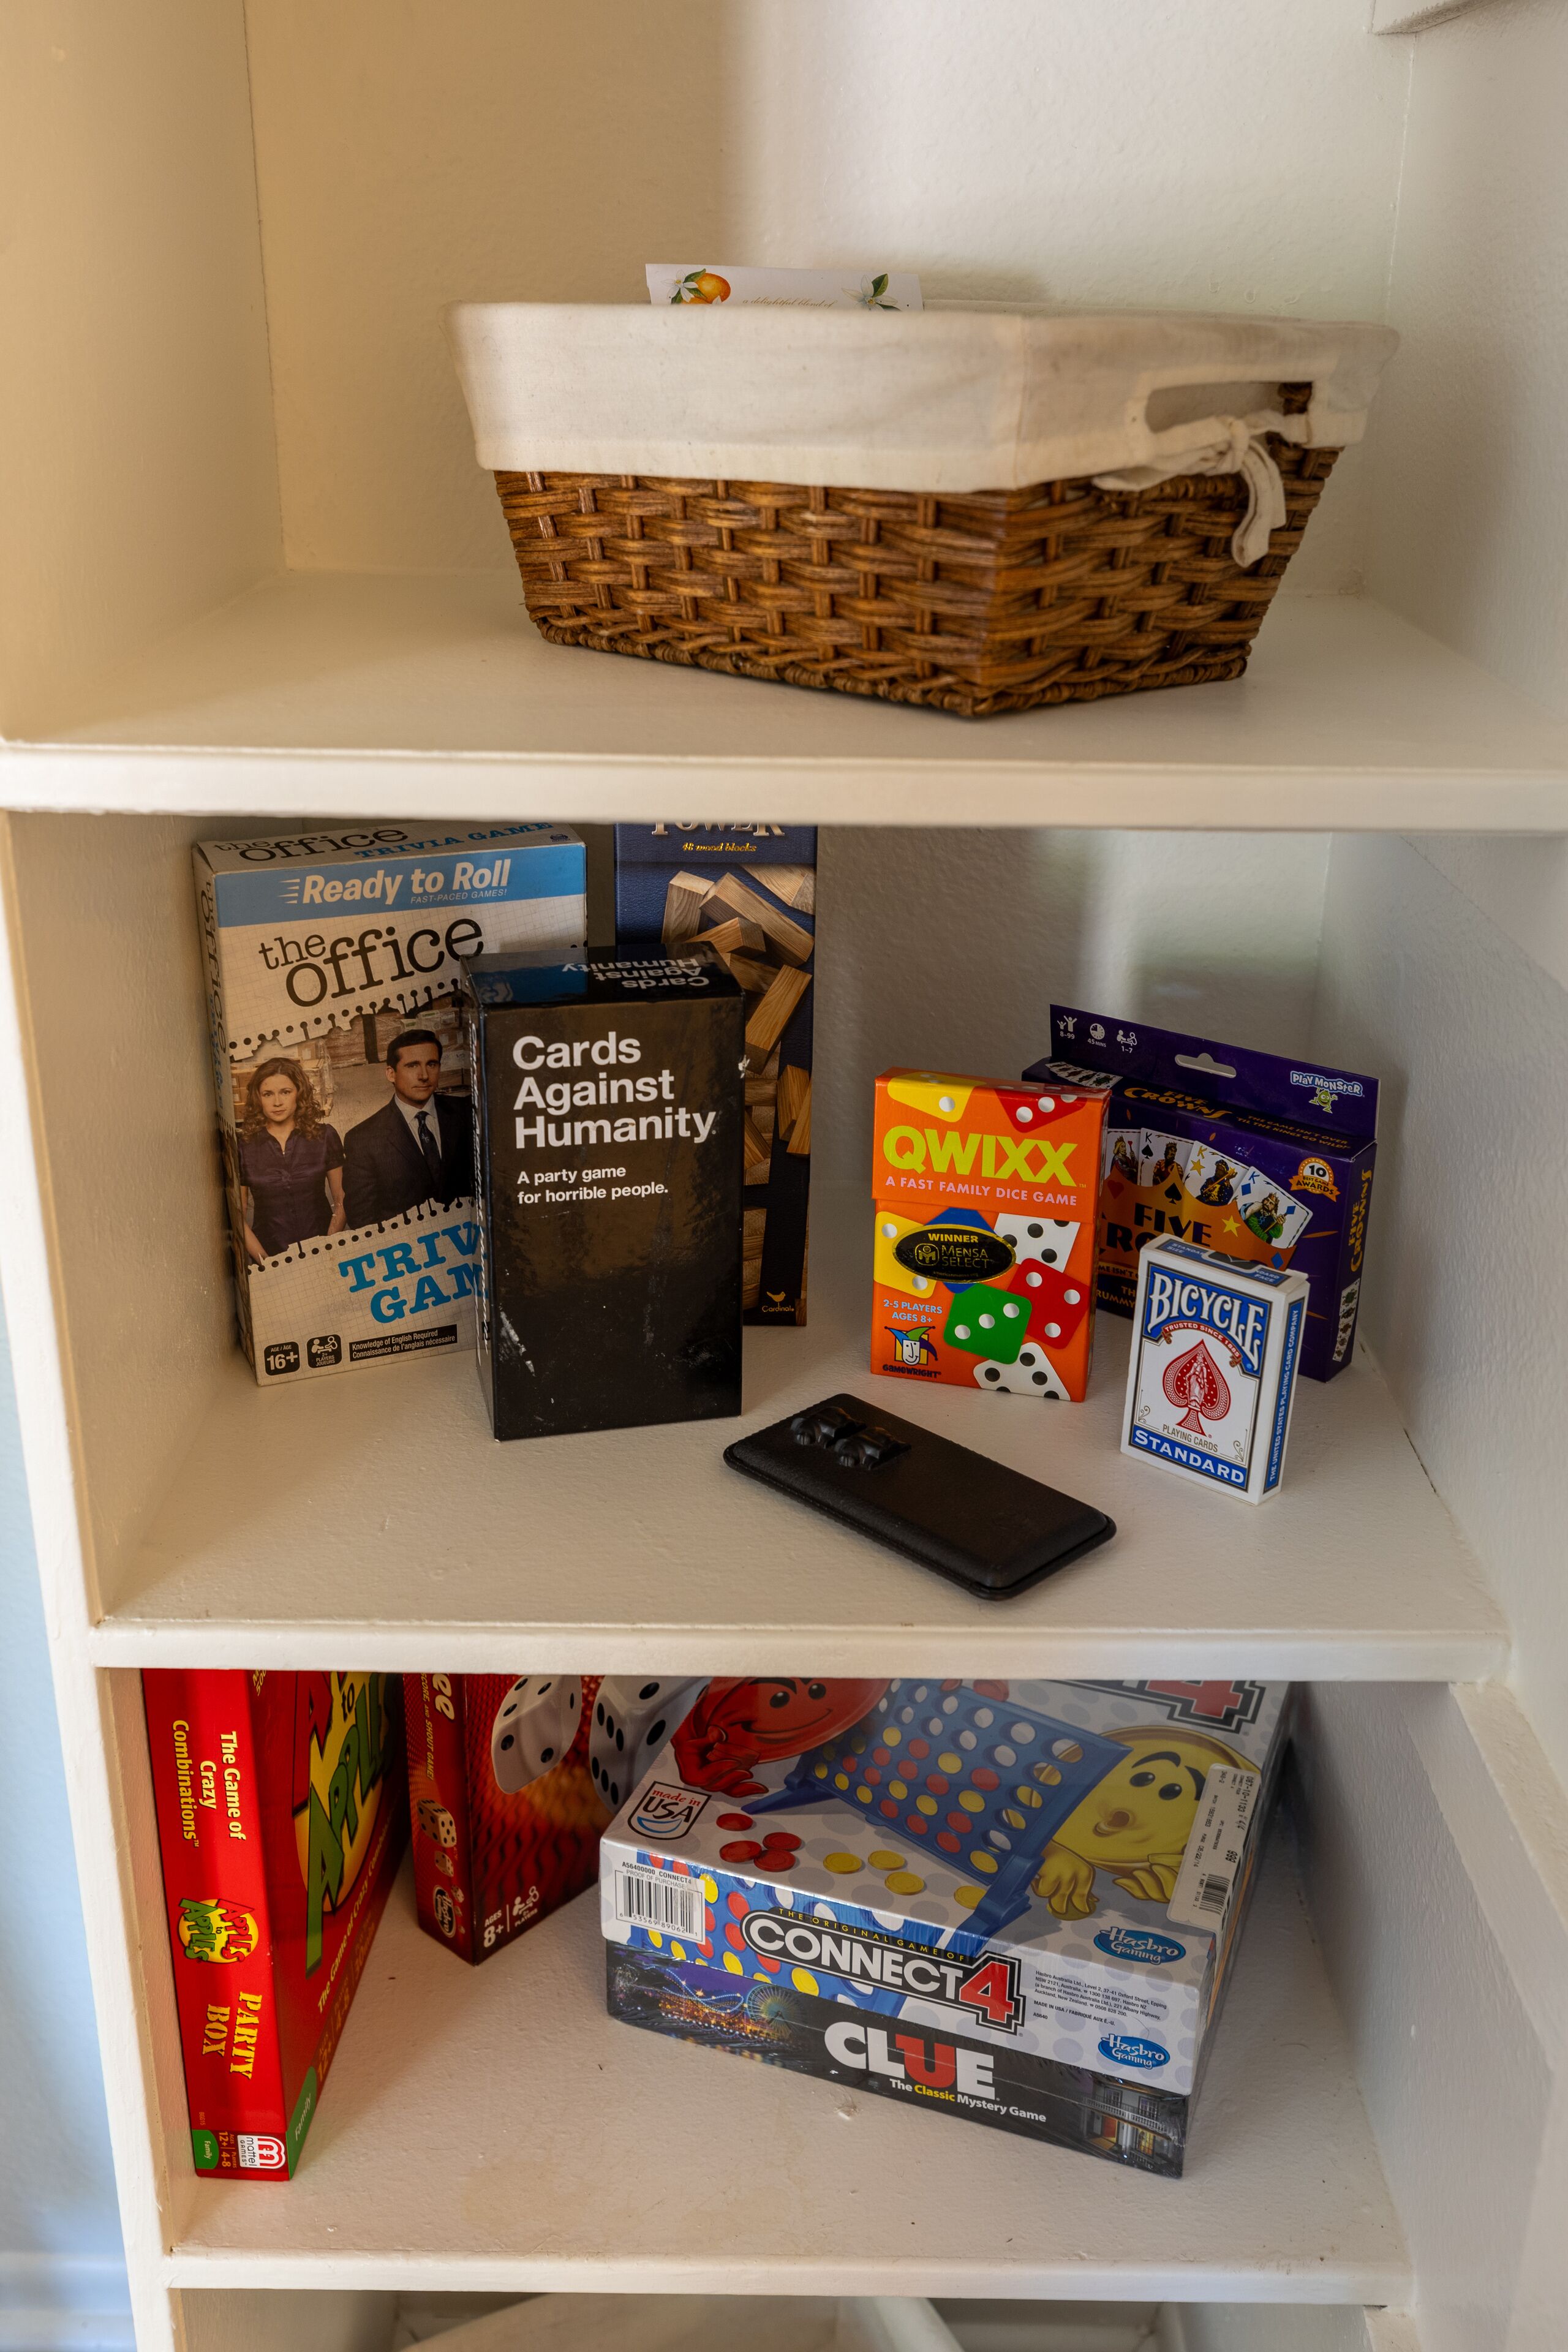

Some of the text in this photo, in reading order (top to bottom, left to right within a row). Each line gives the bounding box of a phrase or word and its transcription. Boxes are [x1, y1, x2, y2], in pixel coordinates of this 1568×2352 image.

[751, 296, 796, 306] delightful
[213, 841, 270, 851] the
[239, 829, 407, 861] office
[355, 836, 464, 857] TRIVIA
[468, 822, 553, 840] GAME
[696, 843, 757, 852] wood blocks
[303, 859, 511, 905] Ready to Roll
[411, 889, 507, 904] FAST-PACED GAMES!
[258, 932, 326, 971] the
[286, 918, 483, 1007] office
[562, 959, 699, 972] Humanity
[595, 966, 701, 981] Against
[621, 978, 709, 990] Cards
[513, 1031, 641, 1070] Cards
[513, 1069, 674, 1115] Against
[1124, 1088, 1234, 1118] CROWNS
[1164, 1091, 1208, 1105] FIVE
[516, 1107, 716, 1149] Humanity
[1145, 1131, 1153, 1144] K
[1267, 1121, 1295, 1131] GAME
[1321, 1135, 1348, 1144] OVER
[1273, 1127, 1300, 1137] KINGS
[883, 1125, 1078, 1187] QWIXX
[518, 1167, 626, 1186] A party game
[1309, 1165, 1326, 1177] 10
[518, 1183, 668, 1204] for horrible people.
[886, 1176, 1077, 1206] A FAST FAMILY DICE GAME
[1296, 1180, 1333, 1194] AWARDS
[1134, 1203, 1212, 1247] FIVE
[1349, 1200, 1360, 1246] FIVE
[1351, 1169, 1372, 1272] CROWNS
[928, 1233, 978, 1243] WINNER
[942, 1245, 988, 1257] MENSA
[338, 1221, 473, 1292] TRIV
[942, 1257, 989, 1268] SELECT
[1254, 1274, 1275, 1283] FACE
[883, 1299, 943, 1314] 2-5 PLAYERS
[892, 1312, 933, 1323] AGES 8+
[1147, 1272, 1264, 1371] BICYCLE
[1289, 1310, 1298, 1347] COMPANY
[352, 1341, 383, 1351] Knowledge
[391, 1335, 412, 1344] English
[413, 1330, 438, 1341] Required
[353, 1347, 391, 1359] Connaissance
[401, 1340, 425, 1351] l'anglais
[426, 1335, 455, 1346] nécessaire
[1165, 1322, 1240, 1357] TRUSTED SINCE 1885
[267, 1351, 298, 1371] 16+
[1280, 1371, 1290, 1408] PLAYING
[1276, 1407, 1285, 1434] STATES
[1163, 1424, 1218, 1452] PLAYING CARDS
[1272, 1436, 1281, 1464] UNITED
[1134, 1430, 1244, 1483] STANDARD
[172, 1720, 197, 1840] Combinations
[199, 1761, 217, 1809] Crazy
[220, 1731, 246, 1841] The Game of
[643, 1796, 696, 1823] USA
[652, 1788, 701, 1807] made in
[622, 1861, 656, 1875] A56400000
[626, 1869, 687, 1890] PROOF PURCHASE
[178, 1898, 219, 1961] APPLES
[215, 1898, 255, 1961] APPLES
[484, 1910, 502, 1927] AGES
[633, 1913, 658, 1926] 53569
[484, 1924, 504, 1947] 8+
[778, 1907, 965, 1961] THE ORIGINAL GAME OF
[1101, 1926, 1179, 1959] Hasbro
[1110, 1942, 1162, 1965] Gaming
[749, 1917, 1014, 2022] CONNECT 4
[1035, 1989, 1088, 2007] Auckland, Zealand.
[1053, 1975, 1072, 1984] Australia
[1118, 1991, 1133, 2000] Oxford
[1134, 1996, 1150, 2005] Street,
[1061, 1983, 1081, 1992] Australia.
[1123, 1999, 1139, 2008] Hasbro
[1063, 1990, 1079, 1999] Hasbro
[1080, 1994, 1100, 2003] Australia
[1123, 2006, 1139, 2015] Albany
[1140, 2010, 1161, 2021] Highway,
[1069, 2009, 1092, 2019] FABRIQUÉ
[202, 2003, 230, 2057] BOX
[230, 1991, 263, 2080] PARTY
[824, 2022, 996, 2100] CLUE
[1102, 2034, 1164, 2061] Hasbro
[1112, 2048, 1156, 2069] Gaming
[889, 2078, 1046, 2122] The Classic Mystery Game
[219, 2132, 228, 2147] 12+
[246, 2137, 257, 2166] mattel
[221, 2152, 231, 2167] 4-8
